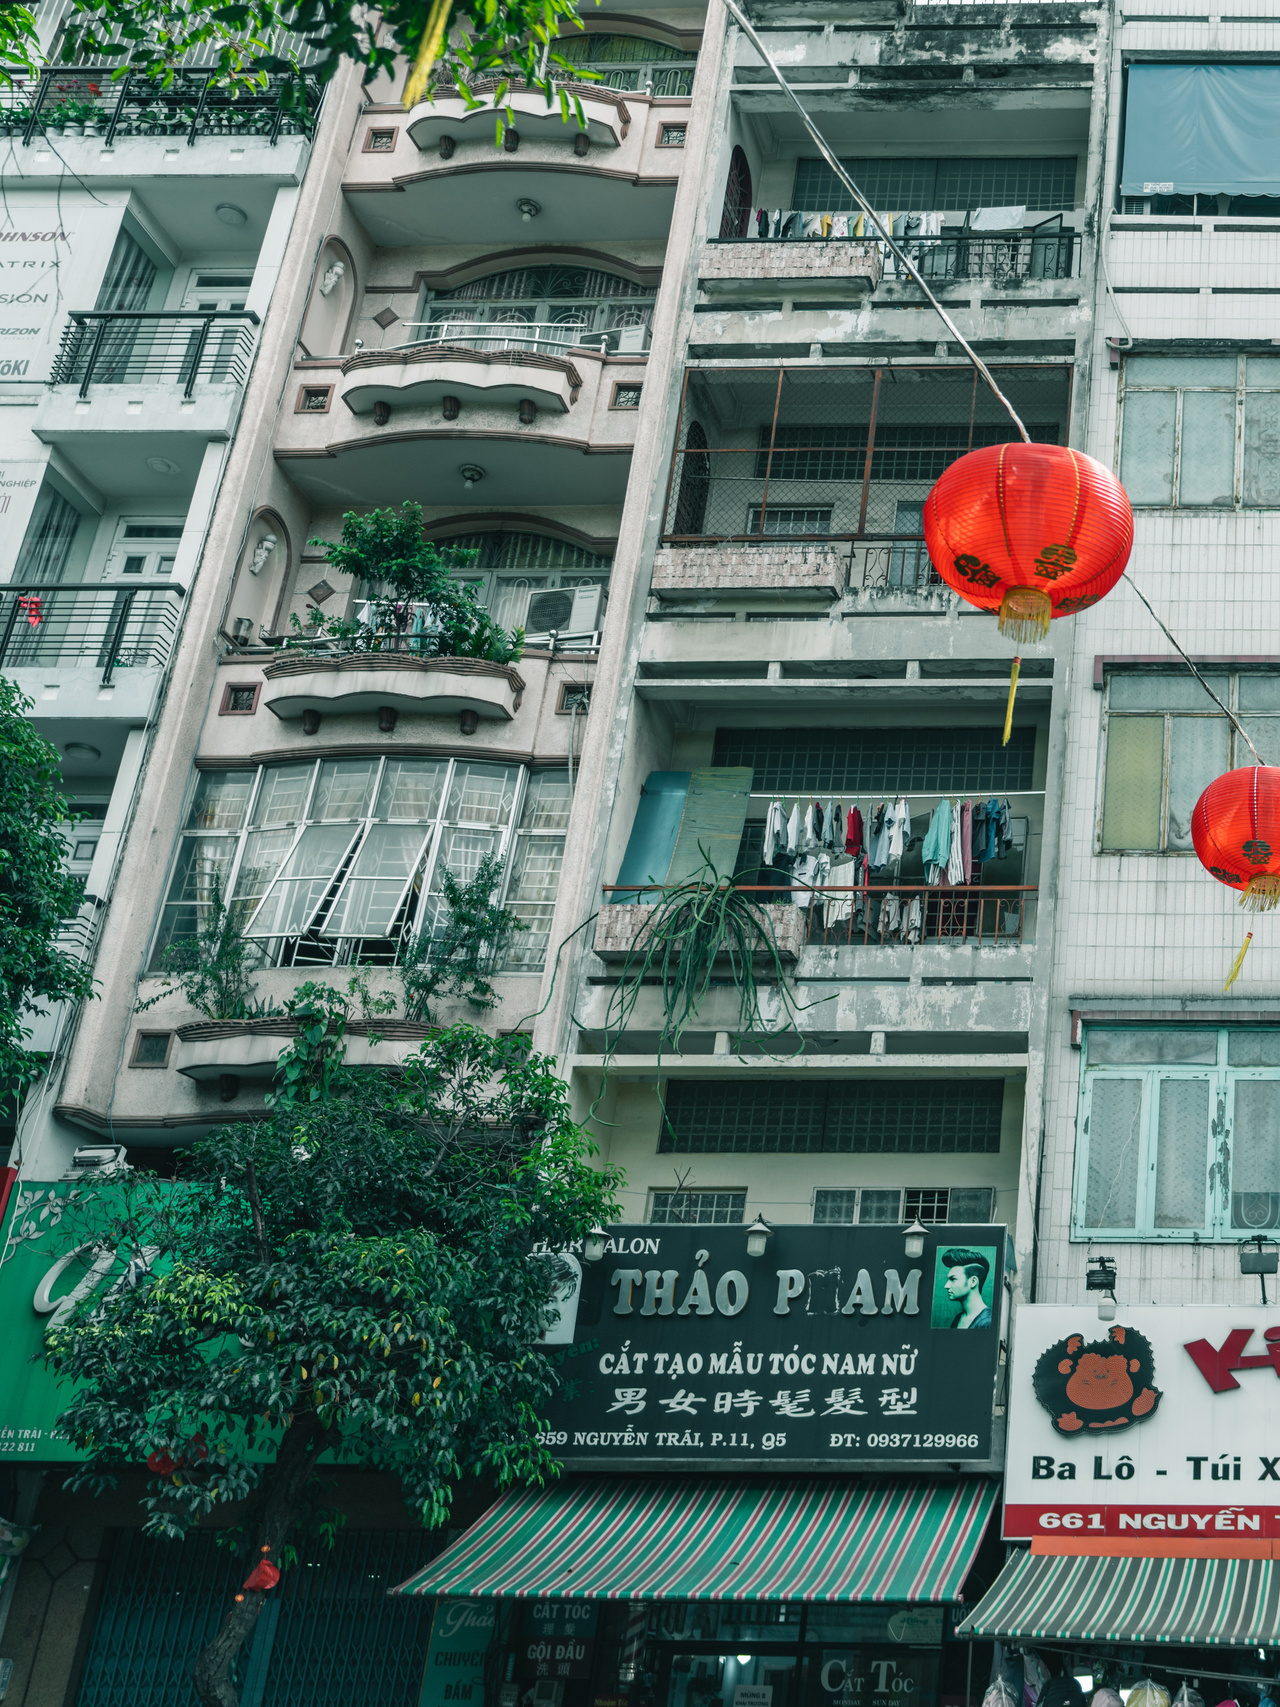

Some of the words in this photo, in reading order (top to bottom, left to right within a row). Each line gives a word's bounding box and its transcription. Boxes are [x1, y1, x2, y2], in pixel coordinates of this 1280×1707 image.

[0, 231, 71, 242] HNSON
[610, 1250, 749, 1316] THẢO
[773, 1267, 922, 1316] PAM
[599, 1341, 648, 1375] CẮT
[654, 1352, 702, 1379] TẠO
[709, 1341, 763, 1375] MẪU
[769, 1344, 816, 1375] TÓC
[821, 1353, 877, 1375] NAM
[881, 1343, 919, 1376] NỮ
[573, 1424, 648, 1446] NGUYỄN
[655, 1429, 704, 1448] TRÃI,
[710, 1432, 754, 1449] P.11,
[762, 1433, 787, 1449] Q5
[829, 1434, 860, 1448] ĐT:
[866, 1434, 979, 1448] 0937129966
[1031, 1456, 1076, 1480] Ba
[1093, 1456, 1135, 1480] Lô
[1186, 1455, 1241, 1481] Túi
[1038, 1511, 1104, 1530] 661
[1118, 1506, 1260, 1531] NGUYỄN
[564, 1601, 591, 1619] TÓC
[870, 1660, 914, 1693] TÓC
